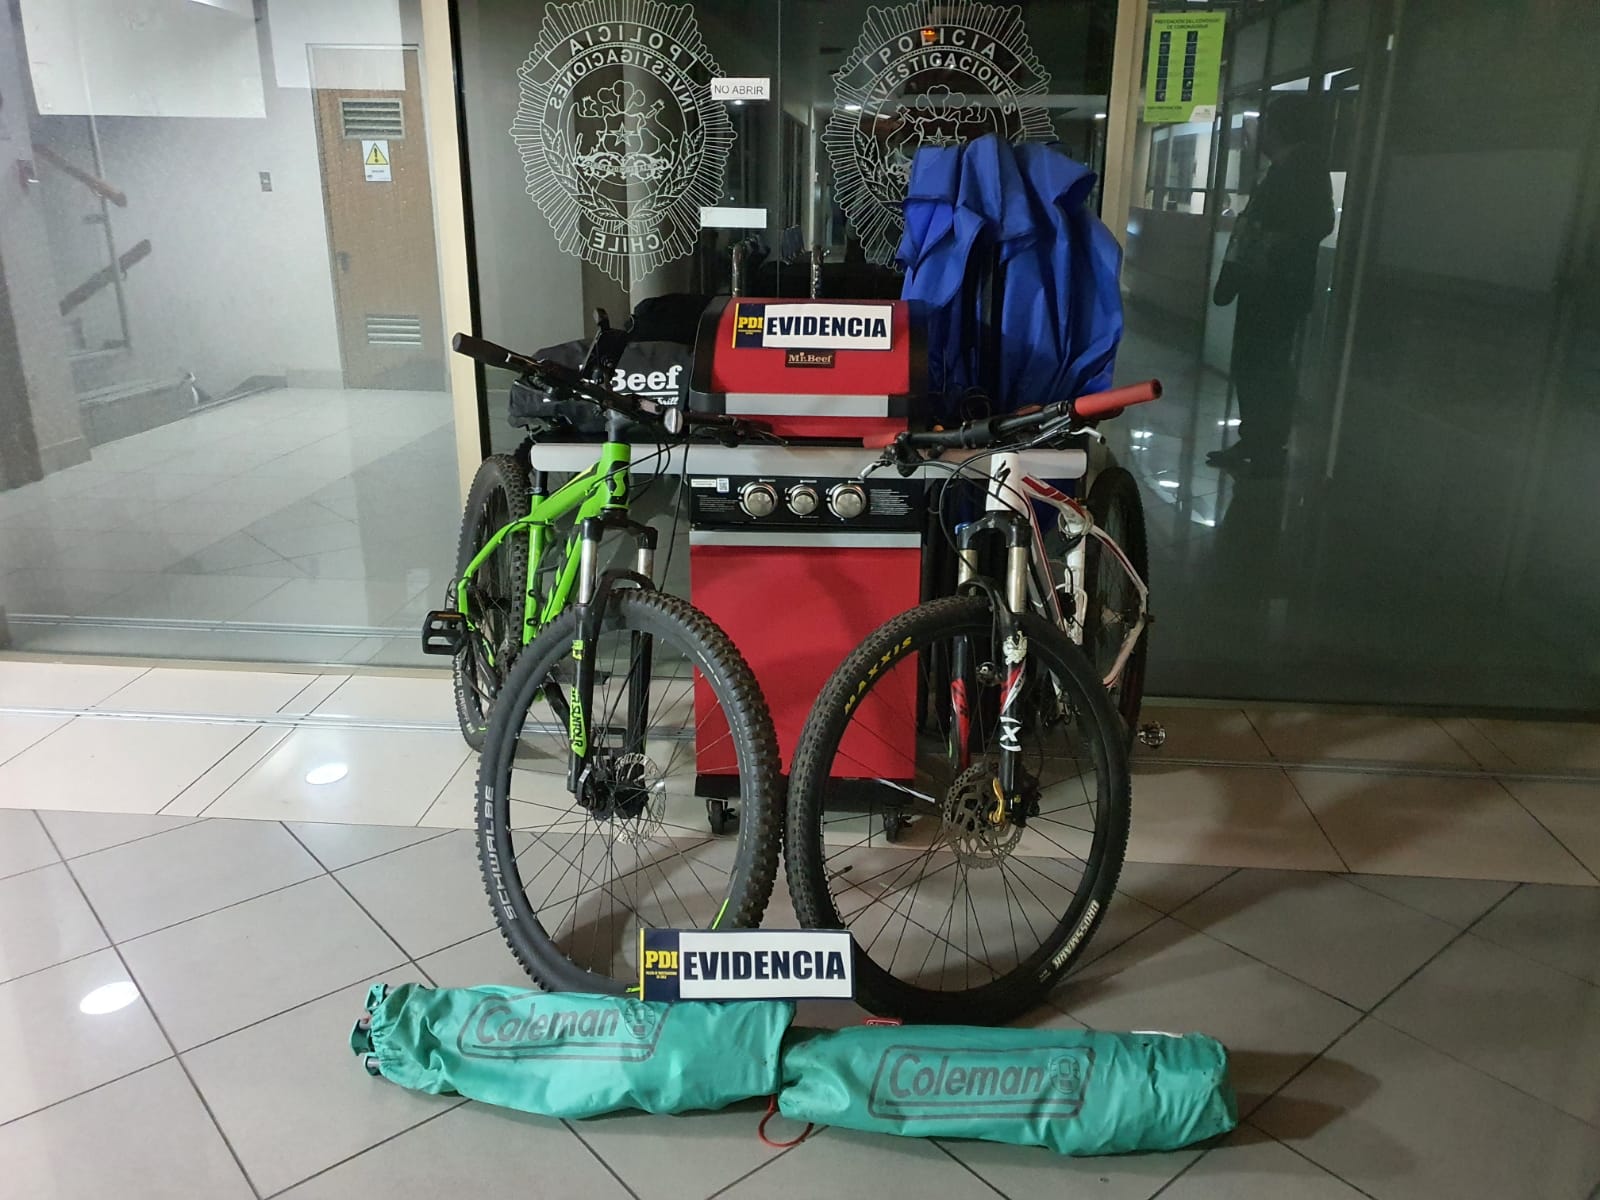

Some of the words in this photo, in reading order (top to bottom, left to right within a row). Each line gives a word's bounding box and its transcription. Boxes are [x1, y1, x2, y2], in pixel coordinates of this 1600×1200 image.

[879, 28, 996, 65] POLICIA
[714, 85, 729, 94] NO
[732, 85, 764, 95] ABRIR
[864, 53, 1016, 116] INVESTIGACIONES
[738, 317, 763, 328] PDI
[766, 316, 887, 337] EVIDENCIA
[844, 636, 912, 715] MAXXIS
[571, 704, 584, 748] SUNTOUR
[483, 785, 518, 921] SCHWALBE
[645, 951, 679, 969] PDI
[683, 951, 846, 980] EVIDENCIA
[476, 1003, 620, 1044] Coleman
[889, 1052, 1046, 1098] Coleman
